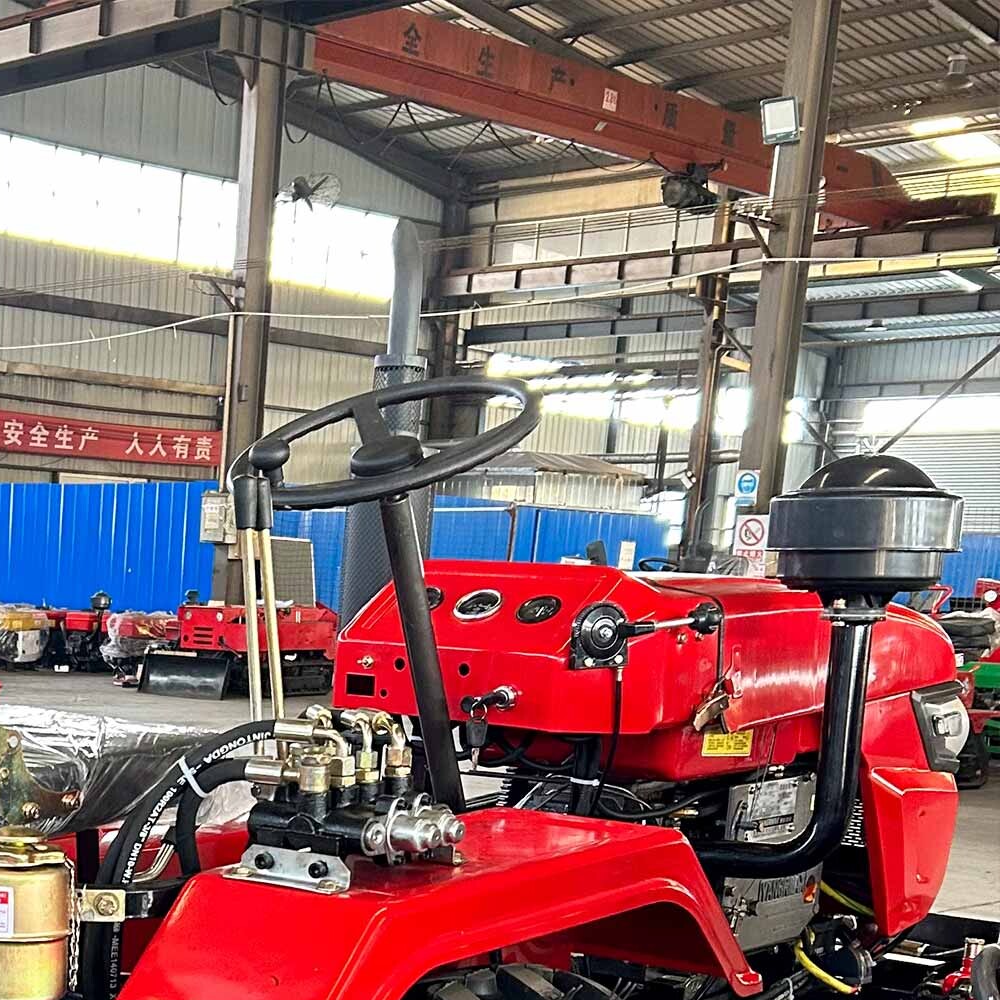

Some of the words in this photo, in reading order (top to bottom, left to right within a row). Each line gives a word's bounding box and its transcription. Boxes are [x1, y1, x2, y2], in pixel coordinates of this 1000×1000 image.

[3, 418, 99, 451] 安全生产
[125, 431, 213, 461] 人人有责
[203, 731, 272, 764] JINTONGDA
